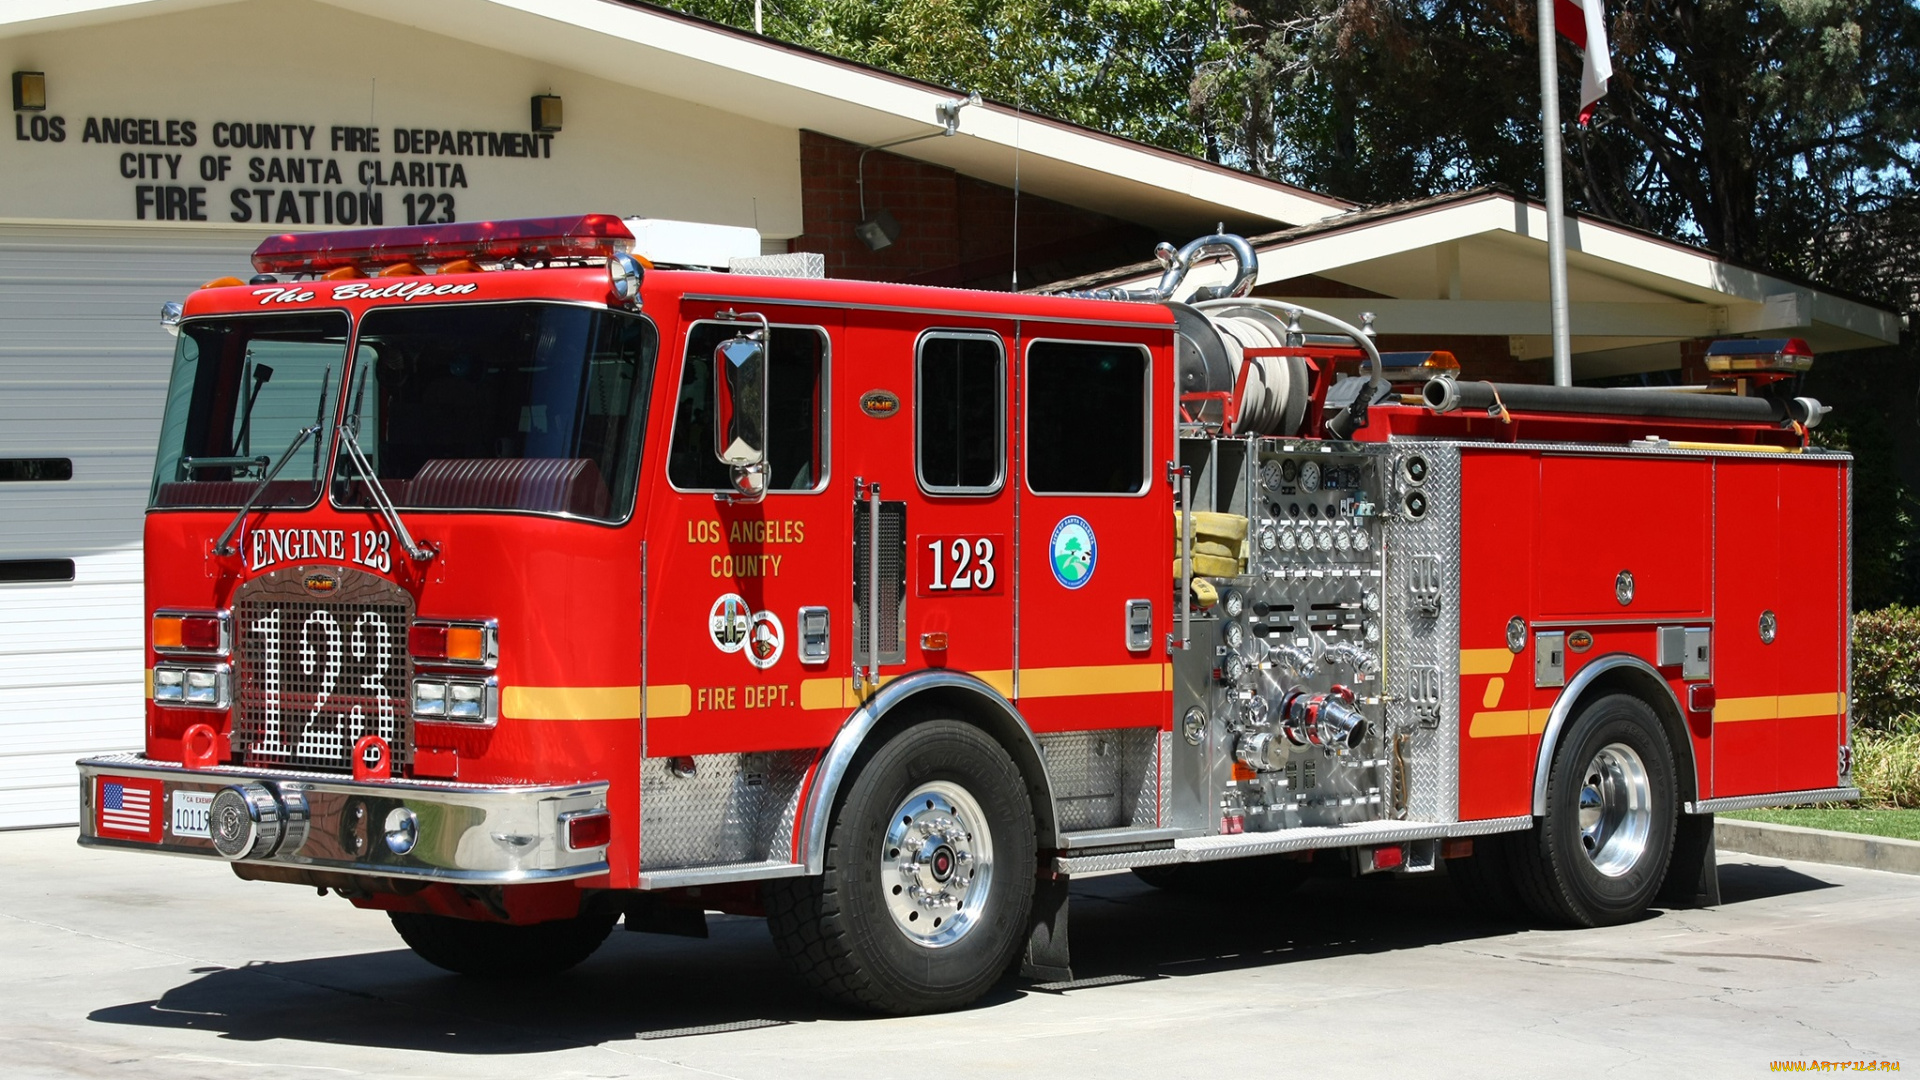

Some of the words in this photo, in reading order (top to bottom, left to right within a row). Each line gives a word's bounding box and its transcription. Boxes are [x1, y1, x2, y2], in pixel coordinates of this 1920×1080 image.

[15, 114, 66, 143] LOS
[82, 117, 197, 147] ANGELES
[212, 122, 316, 150] COUNTY
[331, 126, 380, 153] FIRE
[393, 129, 554, 159] DEPARTMENT
[119, 152, 182, 180] CITY
[200, 155, 231, 181] OF
[248, 157, 342, 185] SANTA
[357, 160, 468, 189] CLARITA
[135, 185, 208, 221] FIRE
[230, 188, 383, 226] STATION
[402, 192, 456, 226] 123
[252, 286, 316, 304] The
[331, 281, 478, 301] Bullpen
[251, 528, 345, 572] ENGINE
[351, 530, 391, 574] 123
[687, 520, 720, 543] LOS
[729, 520, 805, 543] ANGELES
[710, 554, 782, 578] COUNTY
[928, 537, 996, 590] 123
[251, 608, 395, 762] 123
[697, 687, 736, 711] FIRE
[744, 684, 795, 709] DEPT.
